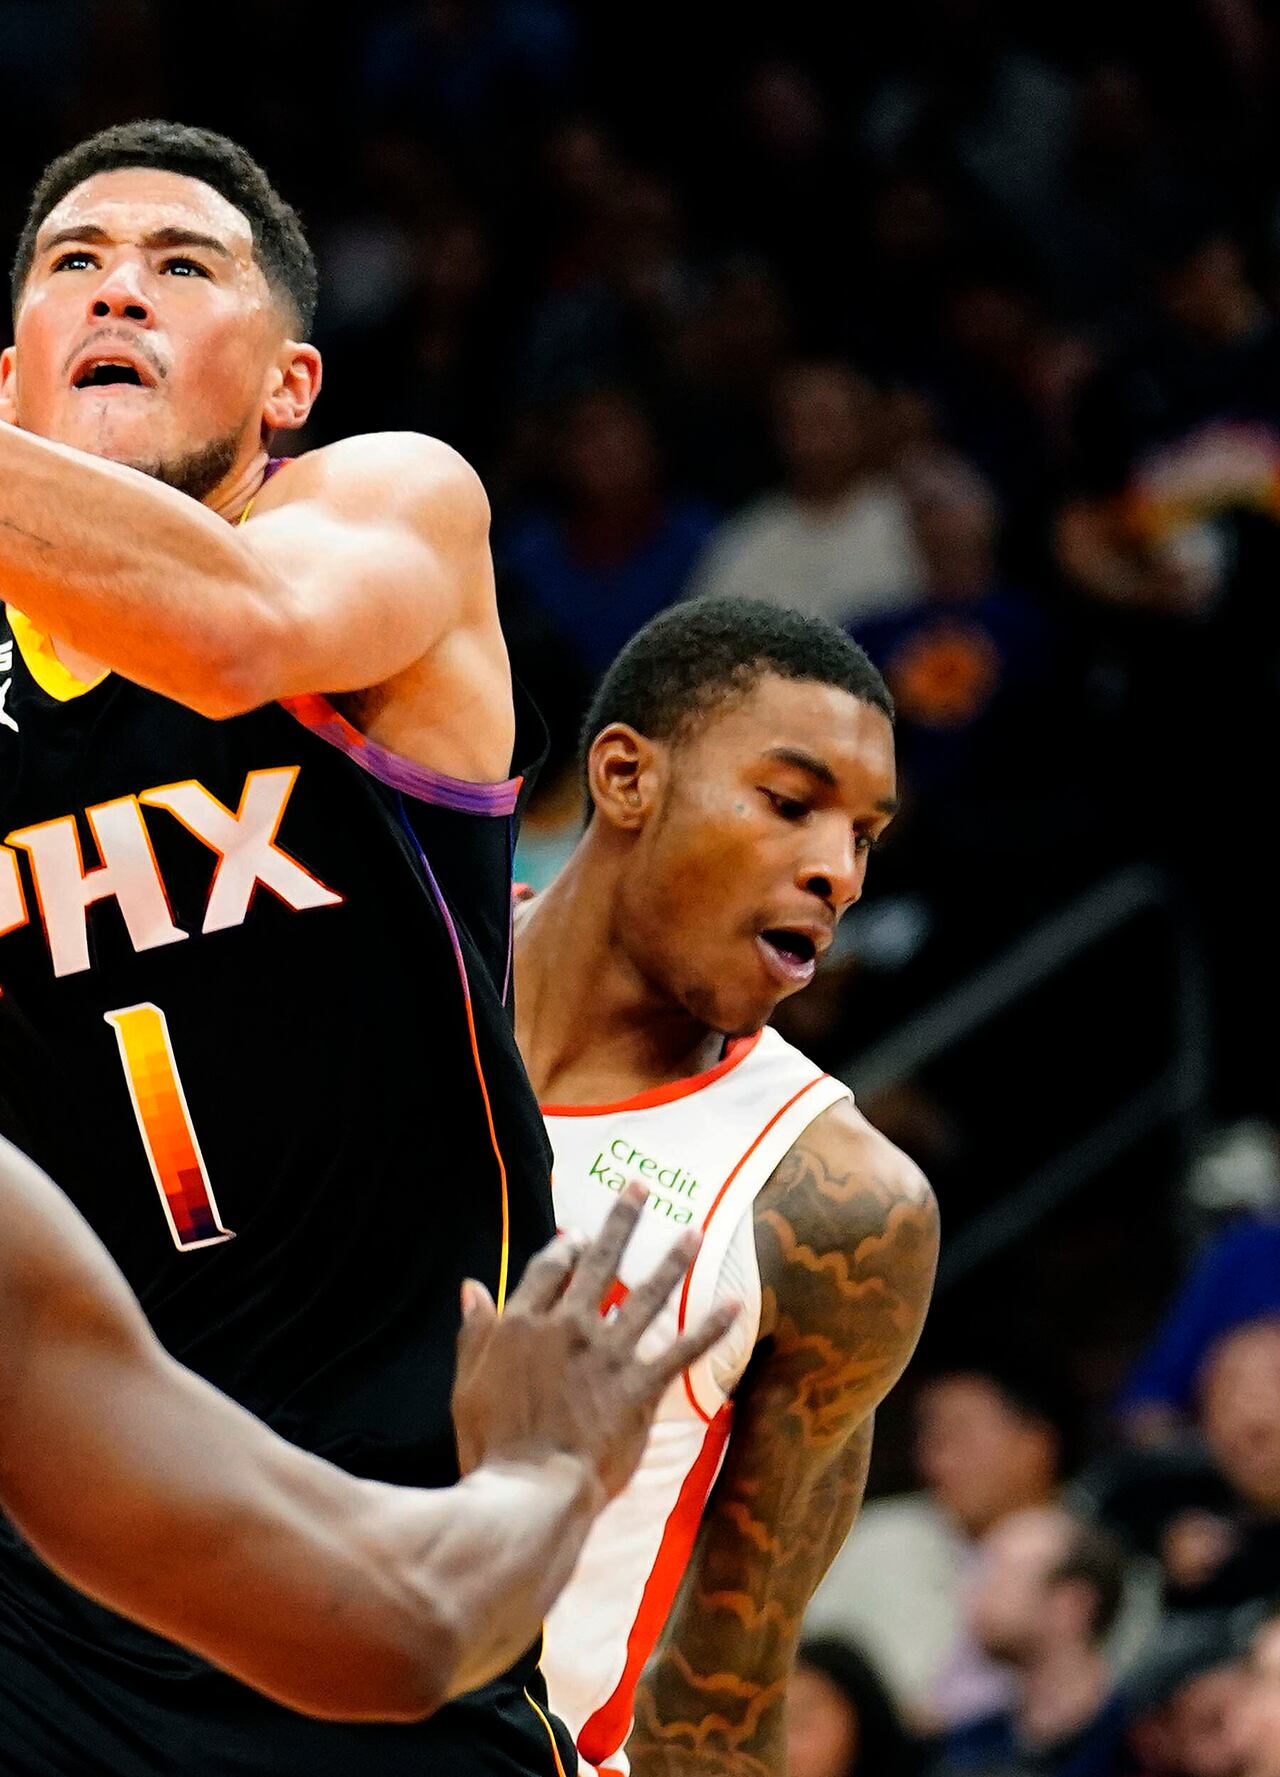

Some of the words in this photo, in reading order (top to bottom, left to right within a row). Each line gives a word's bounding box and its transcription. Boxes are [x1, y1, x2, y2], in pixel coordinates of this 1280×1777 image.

[103, 1001, 237, 1253] 1
[589, 1152, 694, 1225] kama
[610, 1138, 701, 1200] credit
